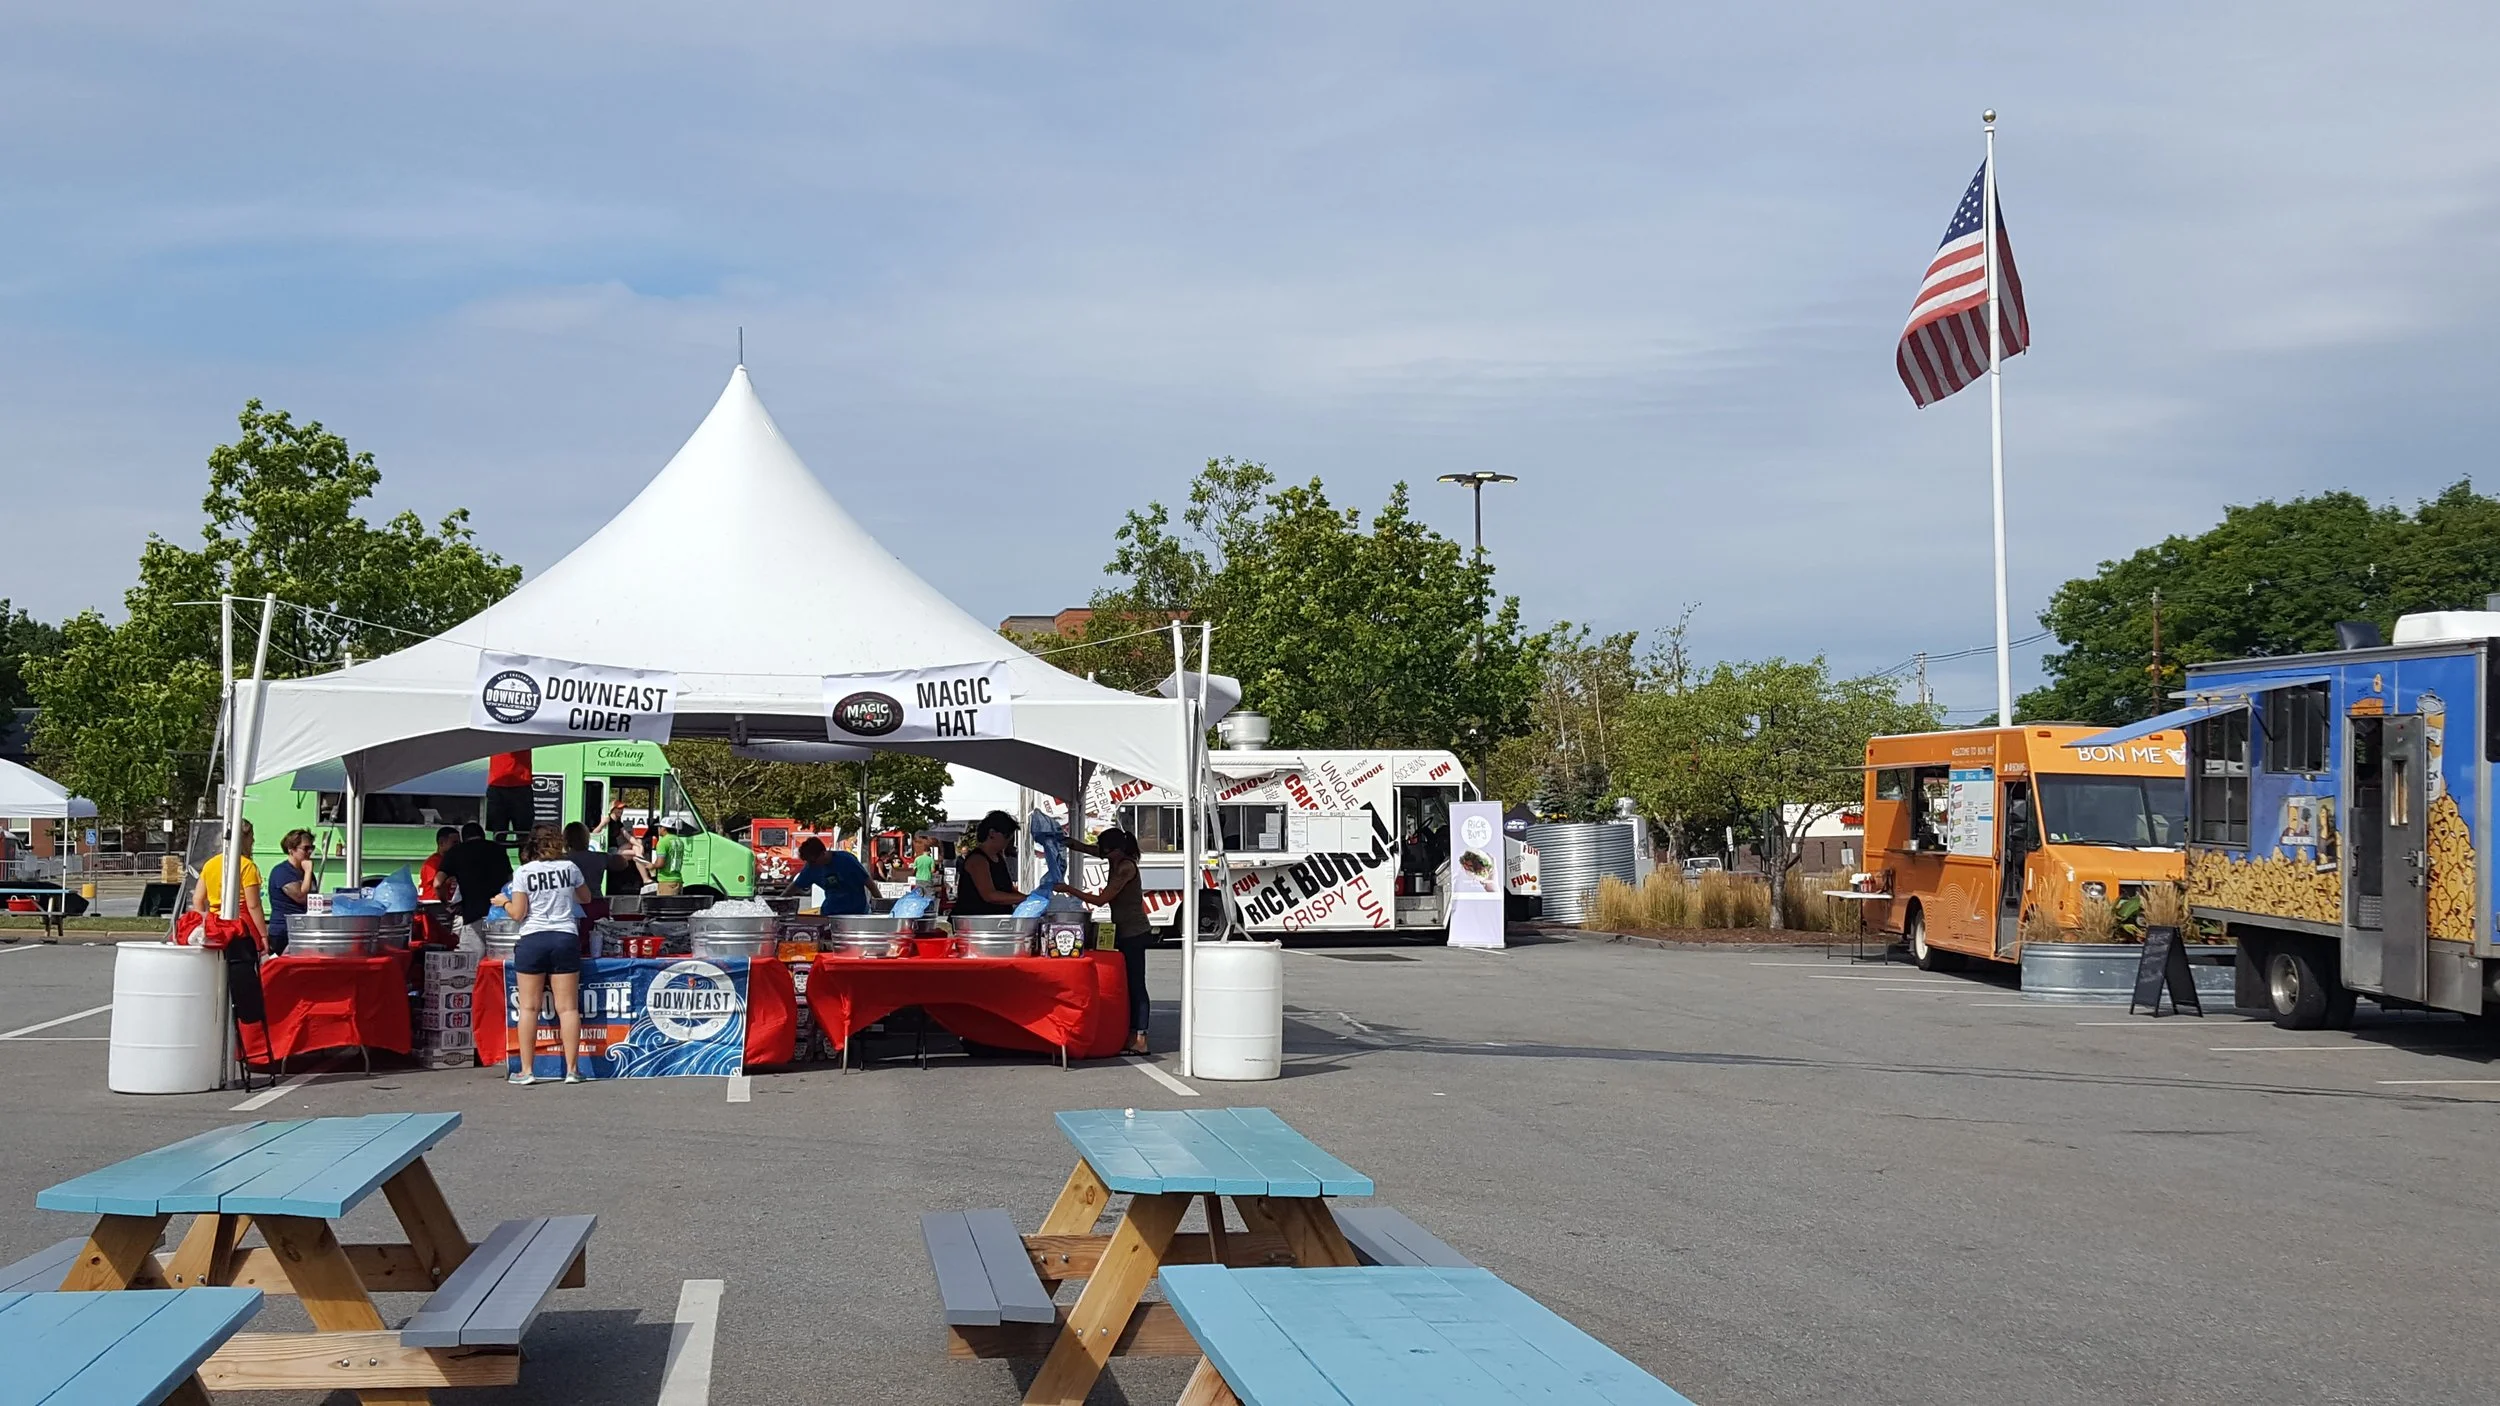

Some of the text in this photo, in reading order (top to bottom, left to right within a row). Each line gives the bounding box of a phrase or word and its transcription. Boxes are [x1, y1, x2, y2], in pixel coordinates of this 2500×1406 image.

[486, 688, 539, 707] DOWNEAST
[545, 676, 668, 713] DOWNEAST
[916, 676, 993, 709] MAGIC
[568, 707, 632, 732] CIDER
[847, 703, 890, 718] MAGIC
[851, 719, 885, 729] HAT
[935, 709, 978, 737] HAT
[598, 746, 645, 762] Catering
[2078, 746, 2164, 764] BON ME
[1345, 758, 1369, 777] HEALTHY
[1351, 763, 1385, 788] UNIQUE
[1428, 761, 1451, 781] FUN
[1321, 760, 1358, 811] UNIQUE
[1522, 844, 1539, 857] FUN
[527, 869, 571, 892] CREW
[1232, 871, 1260, 897] FUN
[1511, 872, 1531, 888] FUN
[1245, 875, 1300, 925] RICE
[1282, 886, 1349, 932] CRISPY
[1347, 875, 1390, 929] FUN
[605, 988, 637, 1019] BE.
[653, 991, 731, 1011] DOWNEAST
